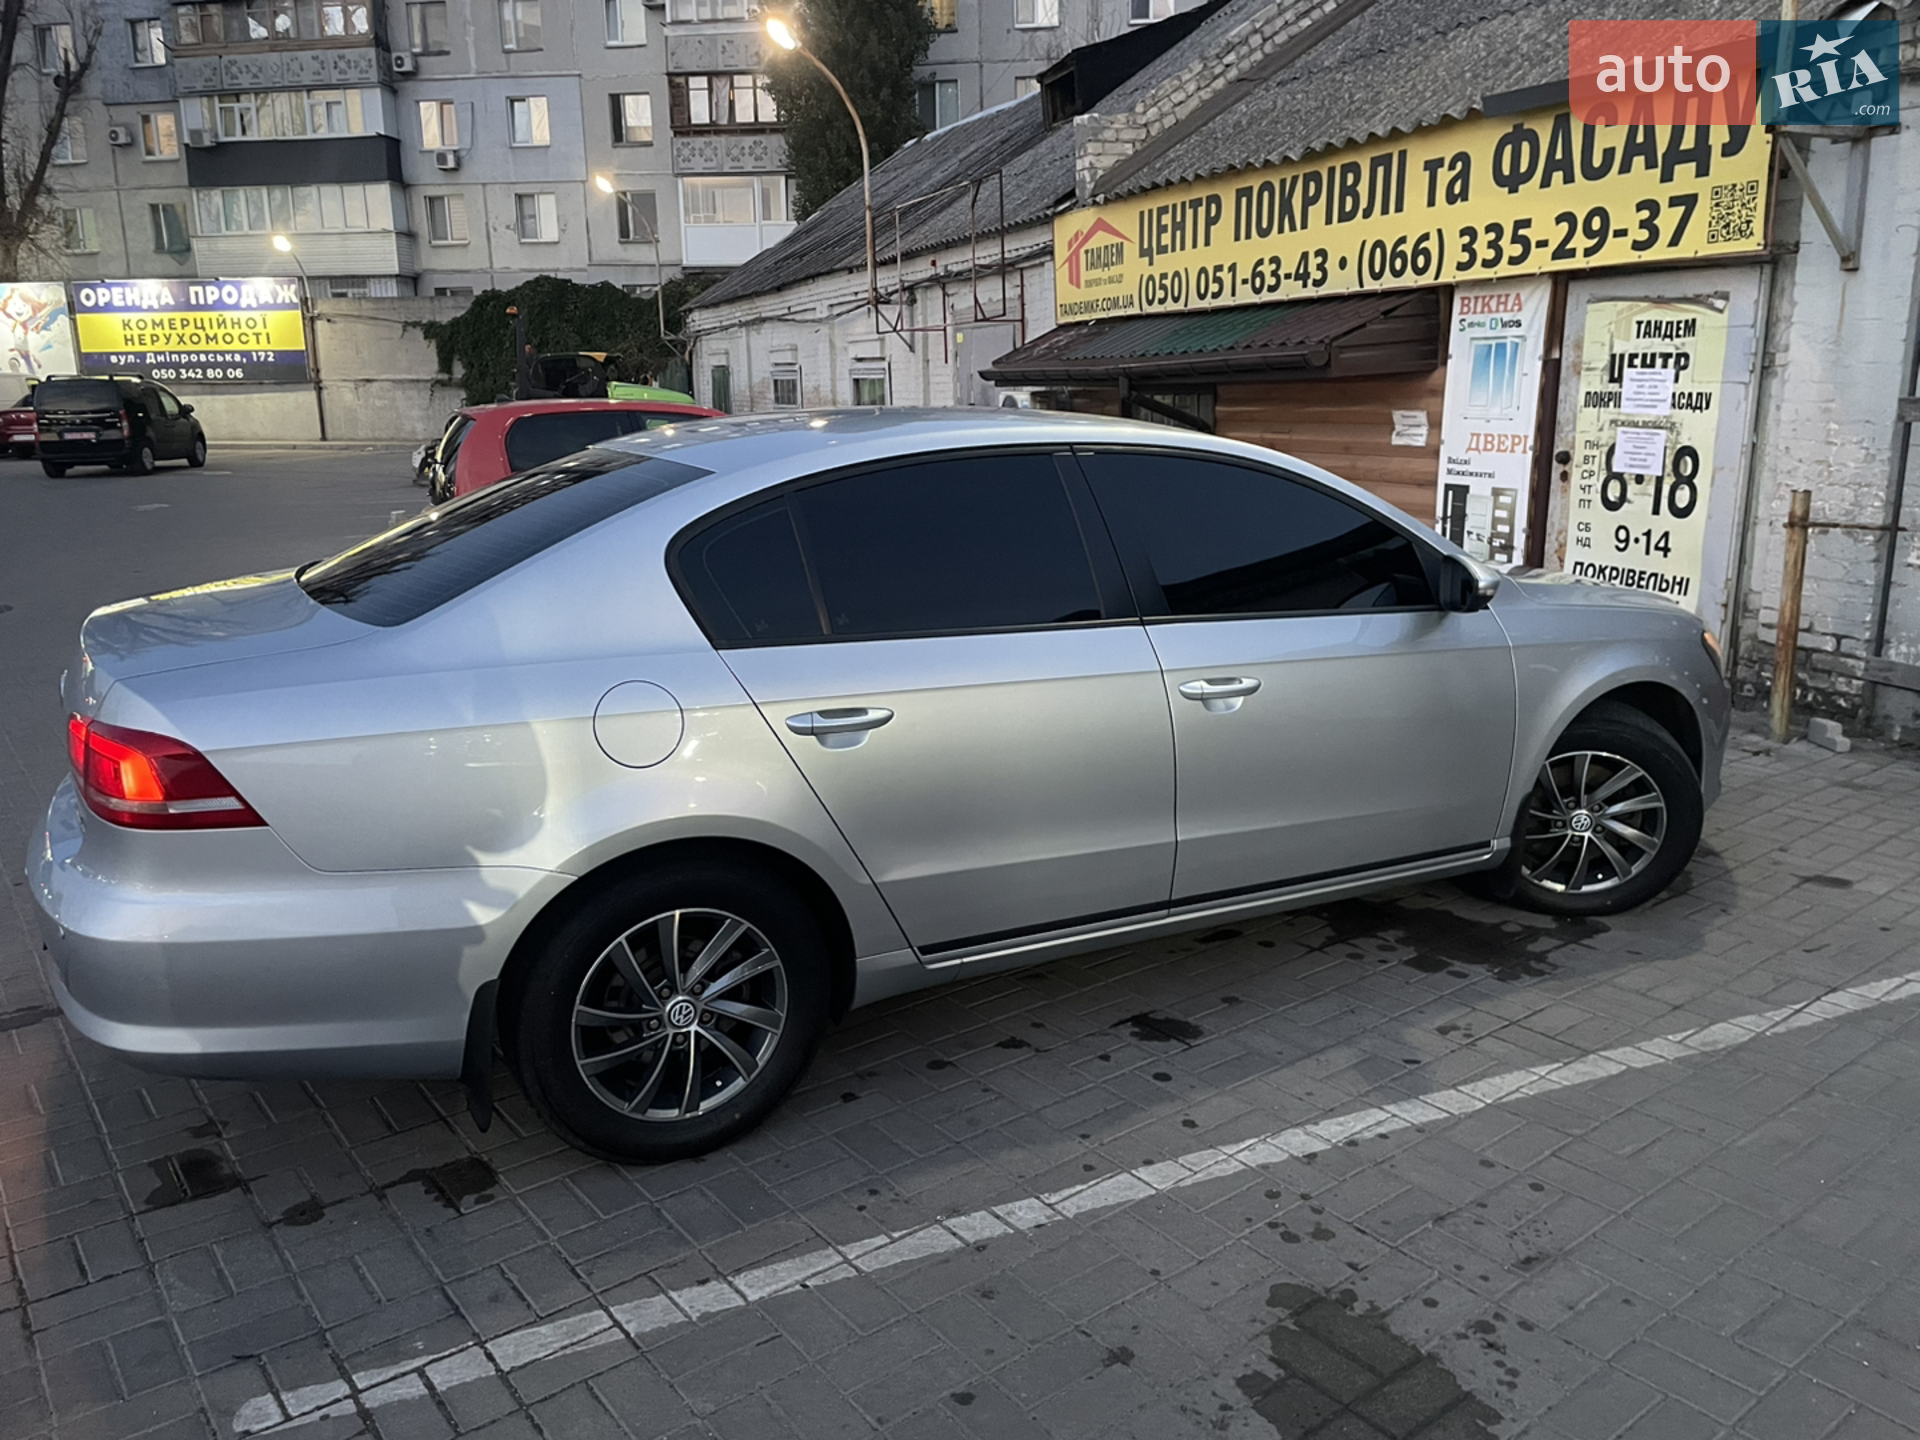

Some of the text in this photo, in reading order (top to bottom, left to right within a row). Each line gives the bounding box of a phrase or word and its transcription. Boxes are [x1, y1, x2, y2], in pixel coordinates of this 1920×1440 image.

[1139, 68, 1762, 266] ЦЕНТР ПОКРІВЛІ та ФАСАДУ
[1084, 242, 1124, 272] ТАНДЕМ
[1138, 193, 1699, 312] (050) 051-63-43 (066) 335-29-37
[80, 284, 299, 310] ОРЕНДА ПРОДАЖ
[1458, 293, 1524, 316] ВІКНА
[122, 313, 267, 332] КОМЕРЦІЙНОЇ
[1635, 318, 1697, 341] ТАНДЕМ
[124, 332, 271, 347] НЕРУХОМОСТІ
[110, 351, 276, 366] вул. Дніпровська, 172
[151, 368, 244, 380] 050 342 80 06
[1671, 391, 1712, 413] АСАДУ
[1465, 432, 1529, 454] ДВЕРІ
[1584, 440, 1600, 450] ПН
[1583, 454, 1598, 465] ВТ
[1581, 469, 1596, 480] СР
[1579, 484, 1593, 495] ЧТ
[1578, 499, 1592, 509] ПТ
[1577, 521, 1591, 532] СБ
[1576, 536, 1591, 549] НД
[1572, 561, 1690, 597] ПОКРІВЕЛЬНІ
